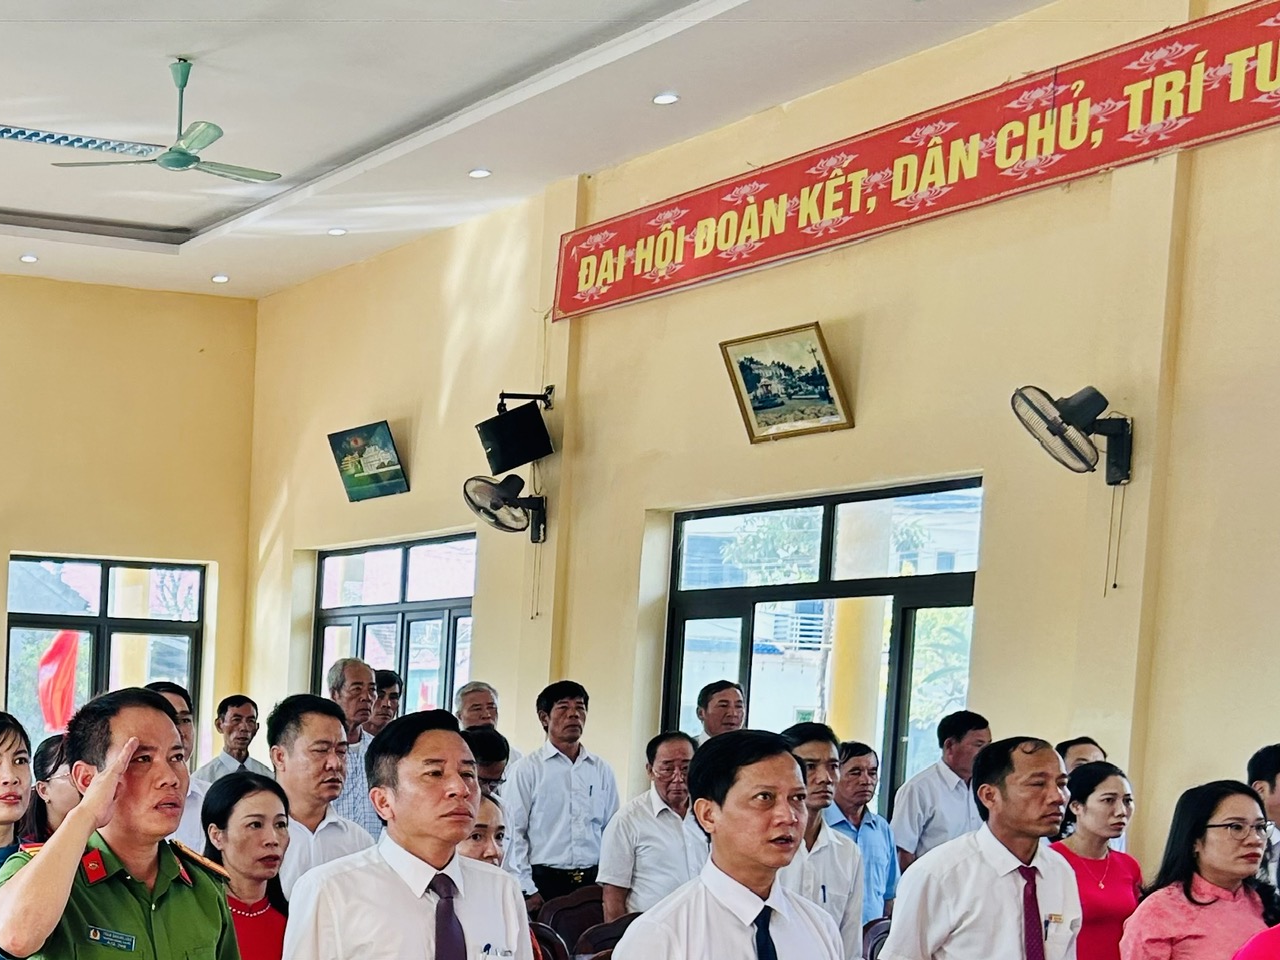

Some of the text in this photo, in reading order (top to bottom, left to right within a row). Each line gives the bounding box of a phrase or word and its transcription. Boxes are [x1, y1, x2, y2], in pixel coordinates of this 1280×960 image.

[577, 245, 627, 294] ĐẠI
[633, 222, 686, 277] HỘI
[693, 194, 788, 260] ĐOÀN
[797, 157, 877, 229] KẾT,
[890, 133, 981, 202] DÂN
[994, 79, 1104, 169] CHỦ,
[1123, 49, 1209, 133] TRÍ
